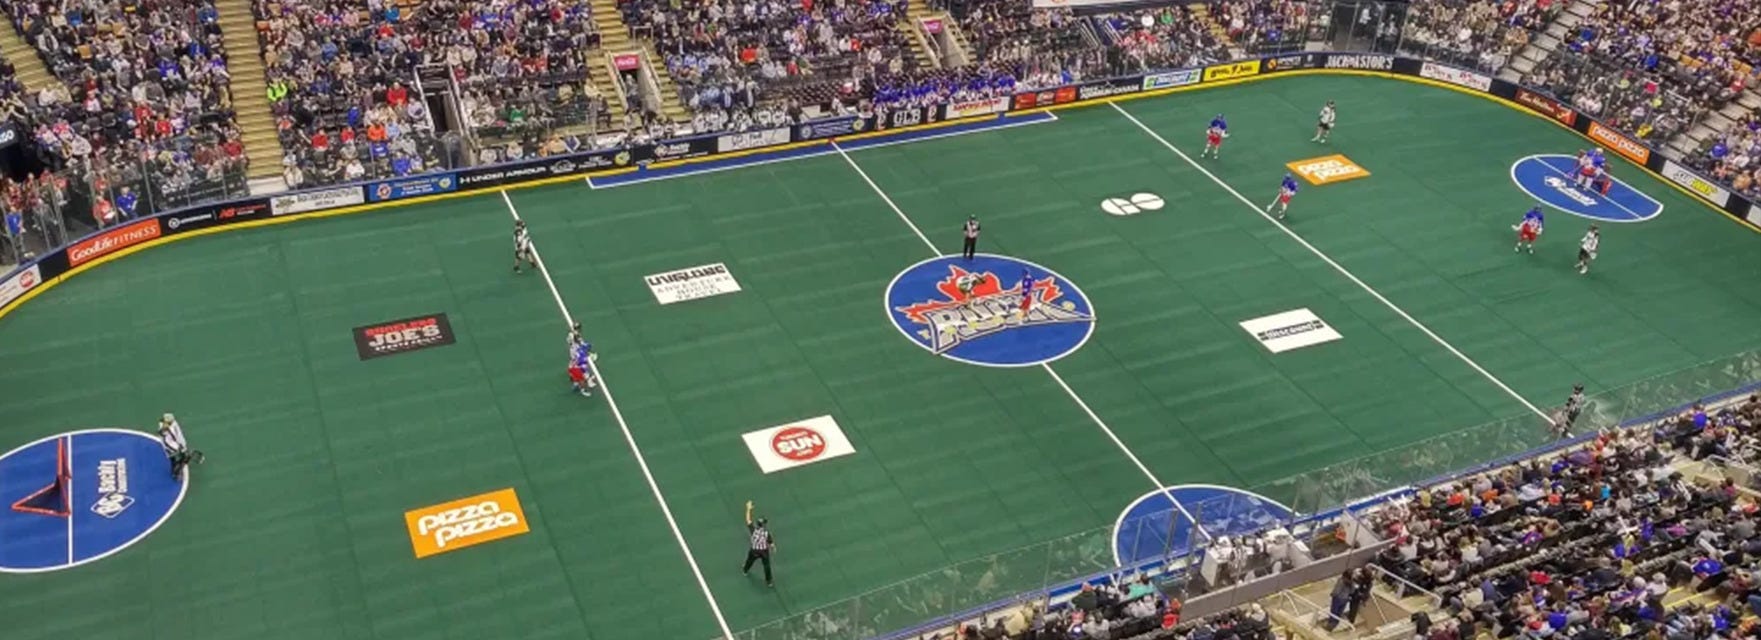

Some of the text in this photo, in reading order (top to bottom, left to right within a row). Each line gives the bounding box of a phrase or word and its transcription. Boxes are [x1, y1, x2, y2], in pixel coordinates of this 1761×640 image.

[368, 324, 441, 347] JOE'S
[776, 434, 823, 454] SUN
[418, 501, 500, 535] pizza
[434, 512, 518, 548] pizza
